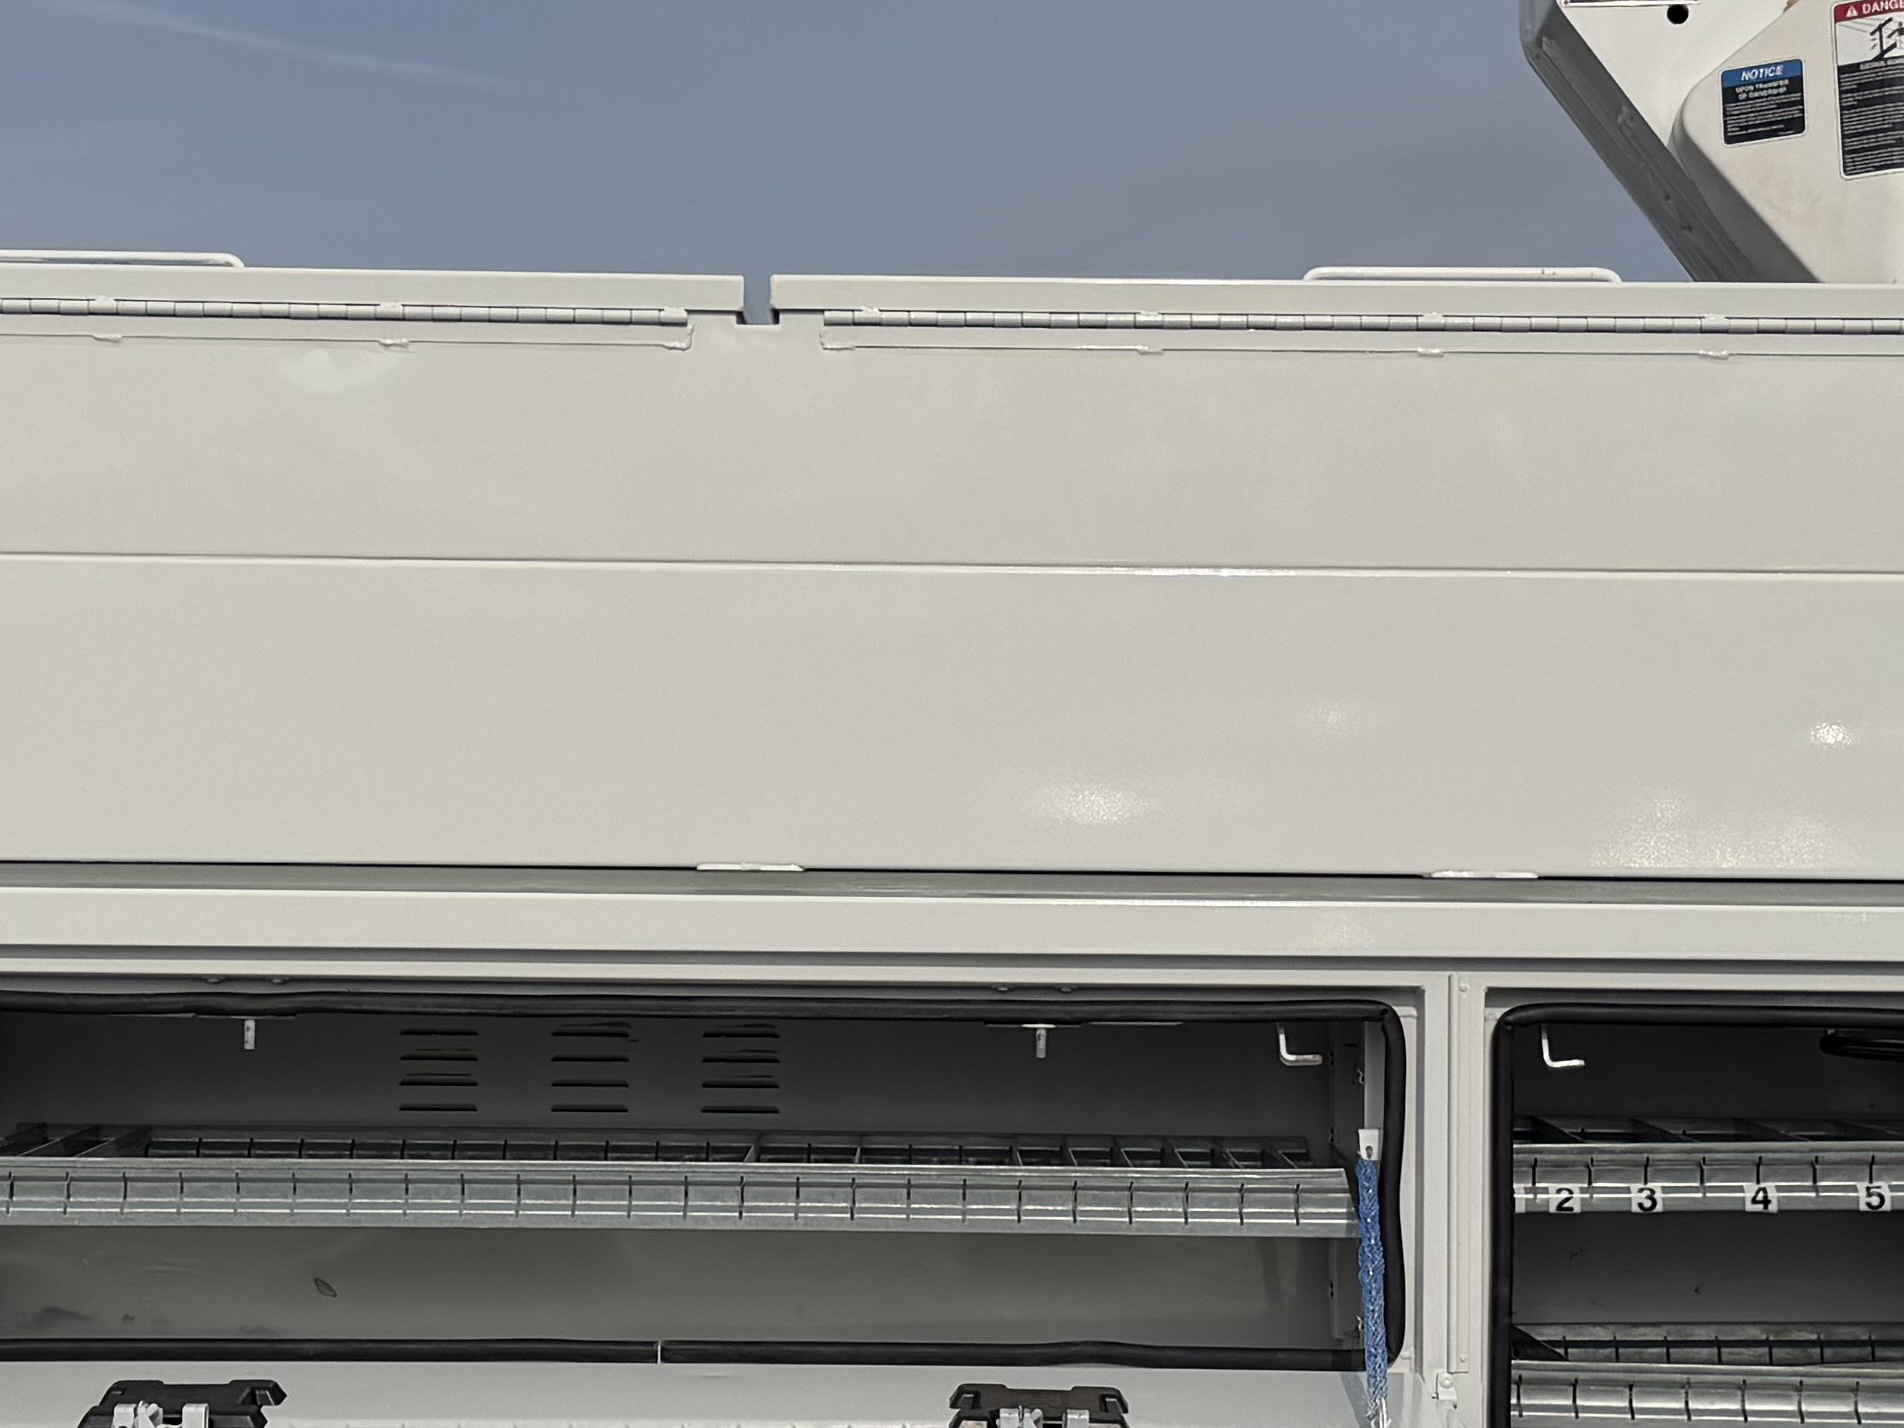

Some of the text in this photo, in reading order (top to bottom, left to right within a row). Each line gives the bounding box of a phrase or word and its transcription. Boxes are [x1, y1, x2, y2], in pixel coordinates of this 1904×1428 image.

[1741, 65, 1784, 81] NOTICE
[1554, 1187, 1575, 1212] 2
[1637, 1187, 1658, 1212] 3
[1750, 1186, 1772, 1211] 4
[1865, 1185, 1886, 1210] 5
